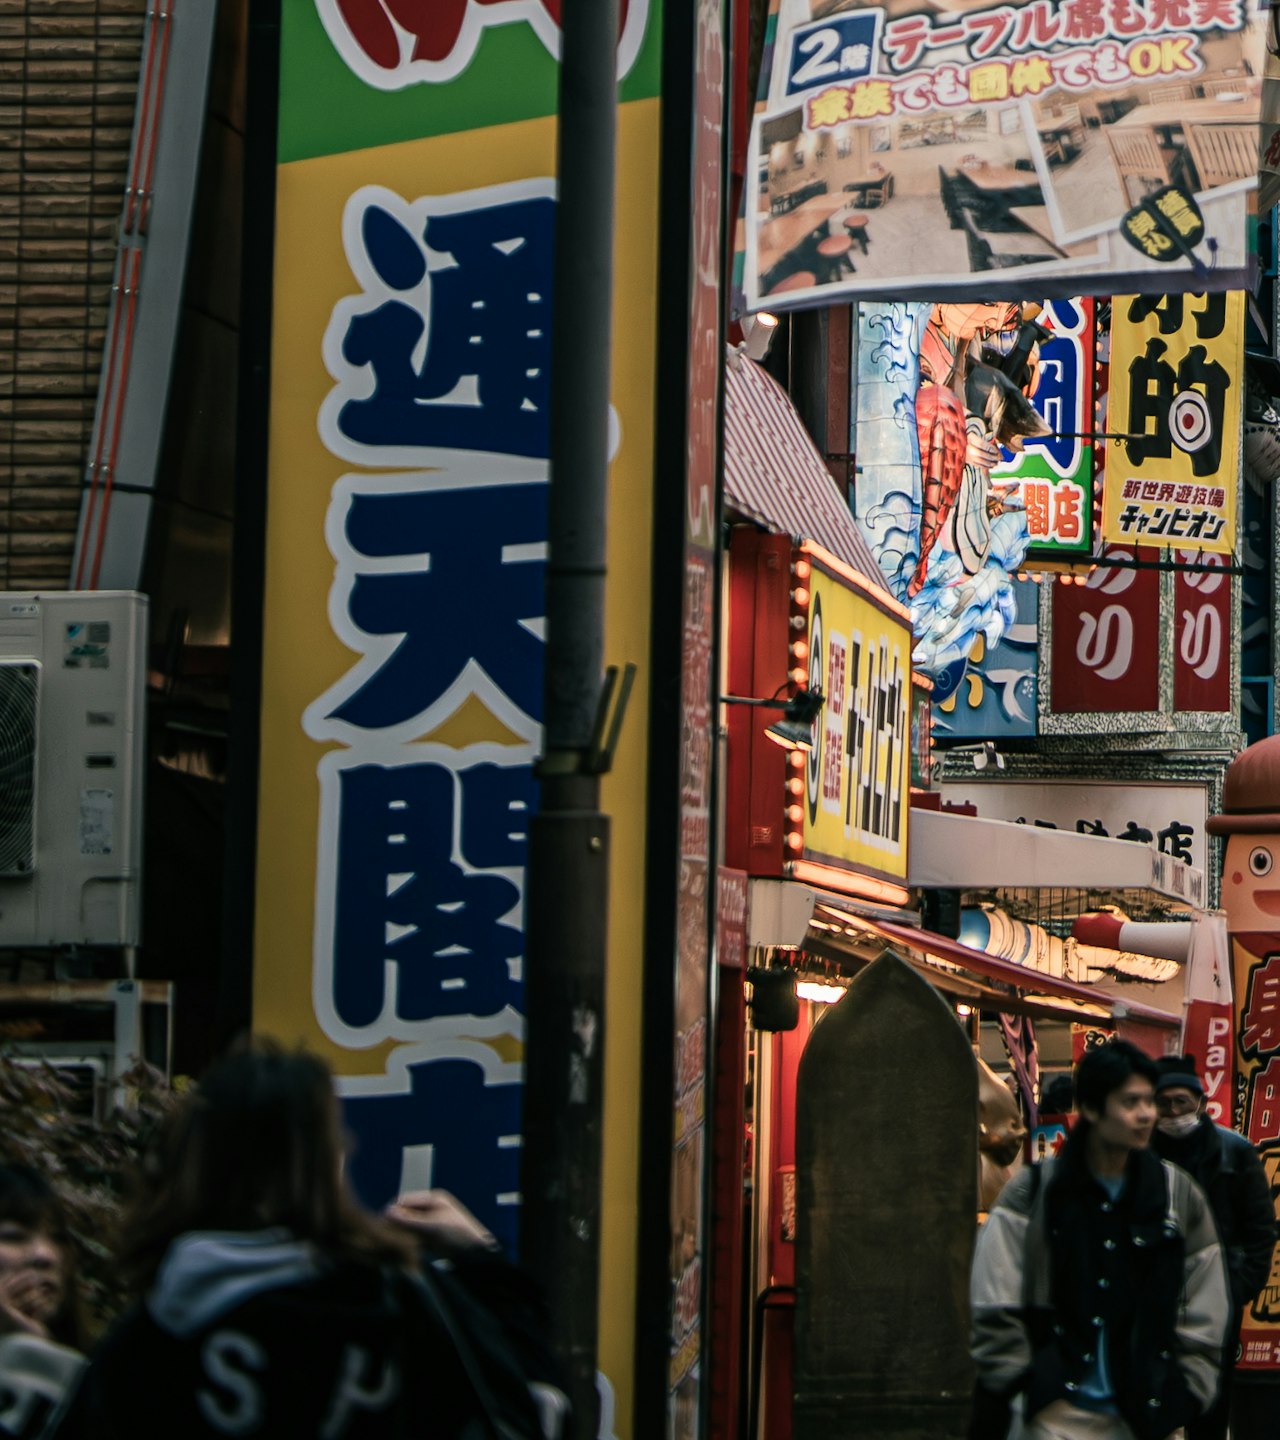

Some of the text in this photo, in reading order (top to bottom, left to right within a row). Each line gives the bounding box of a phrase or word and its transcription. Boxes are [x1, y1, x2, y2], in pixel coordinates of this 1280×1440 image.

[1121, 480, 1225, 508] 新世界遊技場
[1118, 507, 1227, 541] チャンピオン
